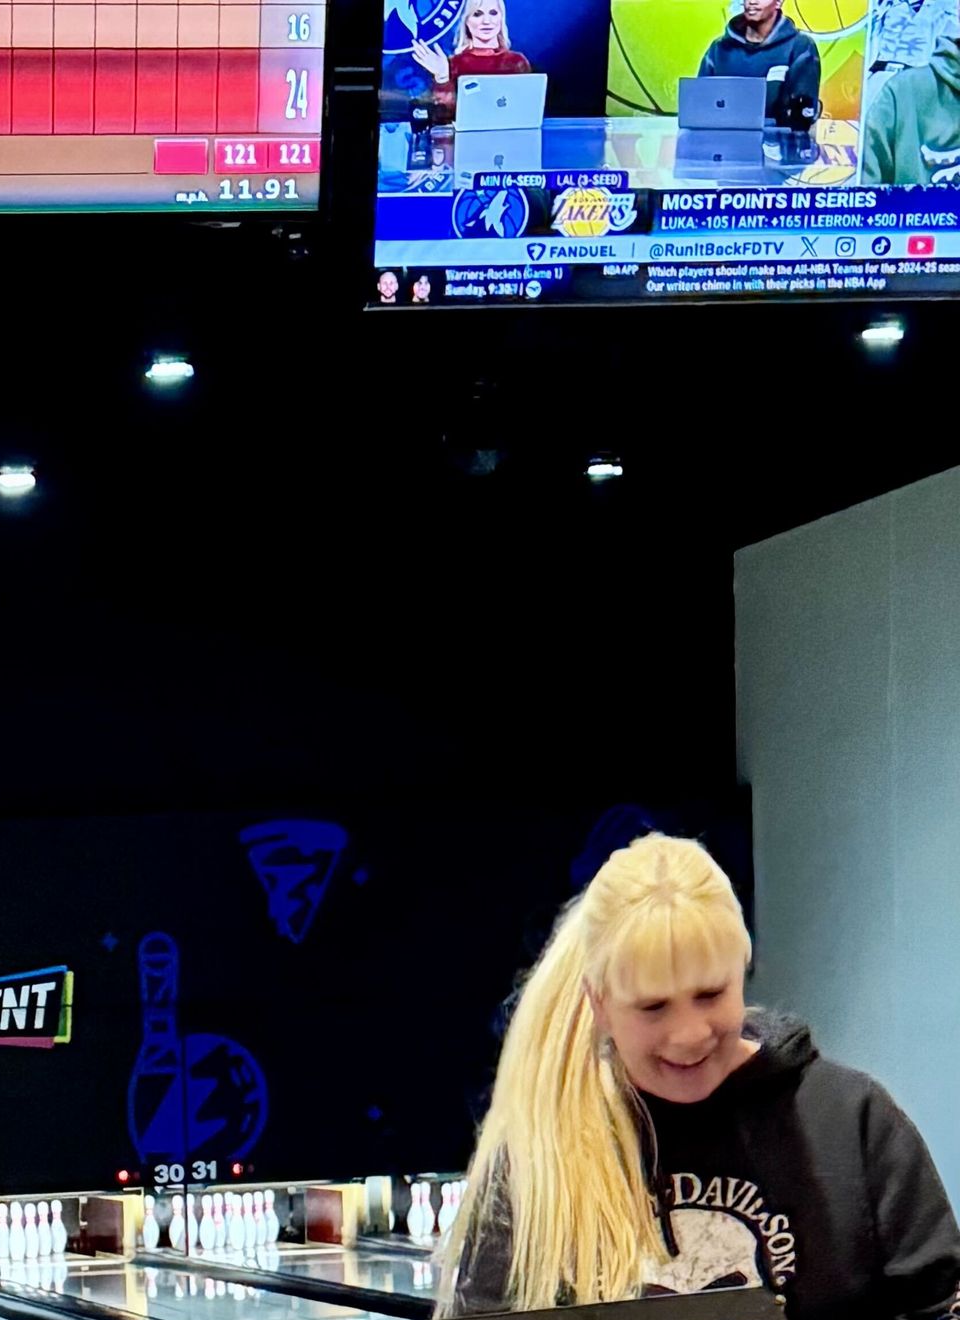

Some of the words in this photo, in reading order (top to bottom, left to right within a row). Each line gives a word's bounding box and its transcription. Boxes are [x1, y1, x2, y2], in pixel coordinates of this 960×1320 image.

[288, 14, 311, 41] 16
[285, 69, 309, 120] 24
[223, 143, 257, 165] 121
[279, 143, 312, 165] 121
[480, 174, 501, 187] MIN
[502, 173, 547, 188] (6-SEED)
[556, 174, 576, 187] LAL
[577, 173, 623, 188] (3-SEED)
[219, 179, 299, 201] 11.91
[662, 193, 717, 210] MOST
[720, 193, 787, 209] POINTS
[792, 193, 810, 208] IN
[815, 192, 877, 208] SERIES
[661, 216, 699, 230] LUKA:
[701, 215, 729, 229] -105
[739, 215, 768, 229] ANT:
[771, 214, 802, 229] +165
[810, 213, 863, 228] LEBRON:
[867, 213, 897, 227] +500
[905, 212, 958, 227] REAVES:
[549, 245, 617, 258] FANDUEL
[648, 266, 677, 277] Which
[679, 266, 714, 279] players
[715, 264, 748, 276] should
[749, 264, 776, 276] make
[777, 264, 793, 275] the
[832, 263, 864, 274] Teams
[865, 262, 879, 274] for
[881, 262, 897, 274] the
[646, 279, 665, 291] Our
[666, 279, 701, 291] writers
[702, 279, 731, 291] chime
[733, 279, 742, 290] in
[744, 279, 765, 290] with
[766, 278, 789, 290] their
[790, 277, 815, 291] picks
[816, 277, 826, 289] in
[827, 278, 843, 289] the
[844, 277, 865, 288] NBA
[866, 277, 886, 290] App
[154, 1164, 185, 1184] 30
[192, 1160, 217, 1180] 31
